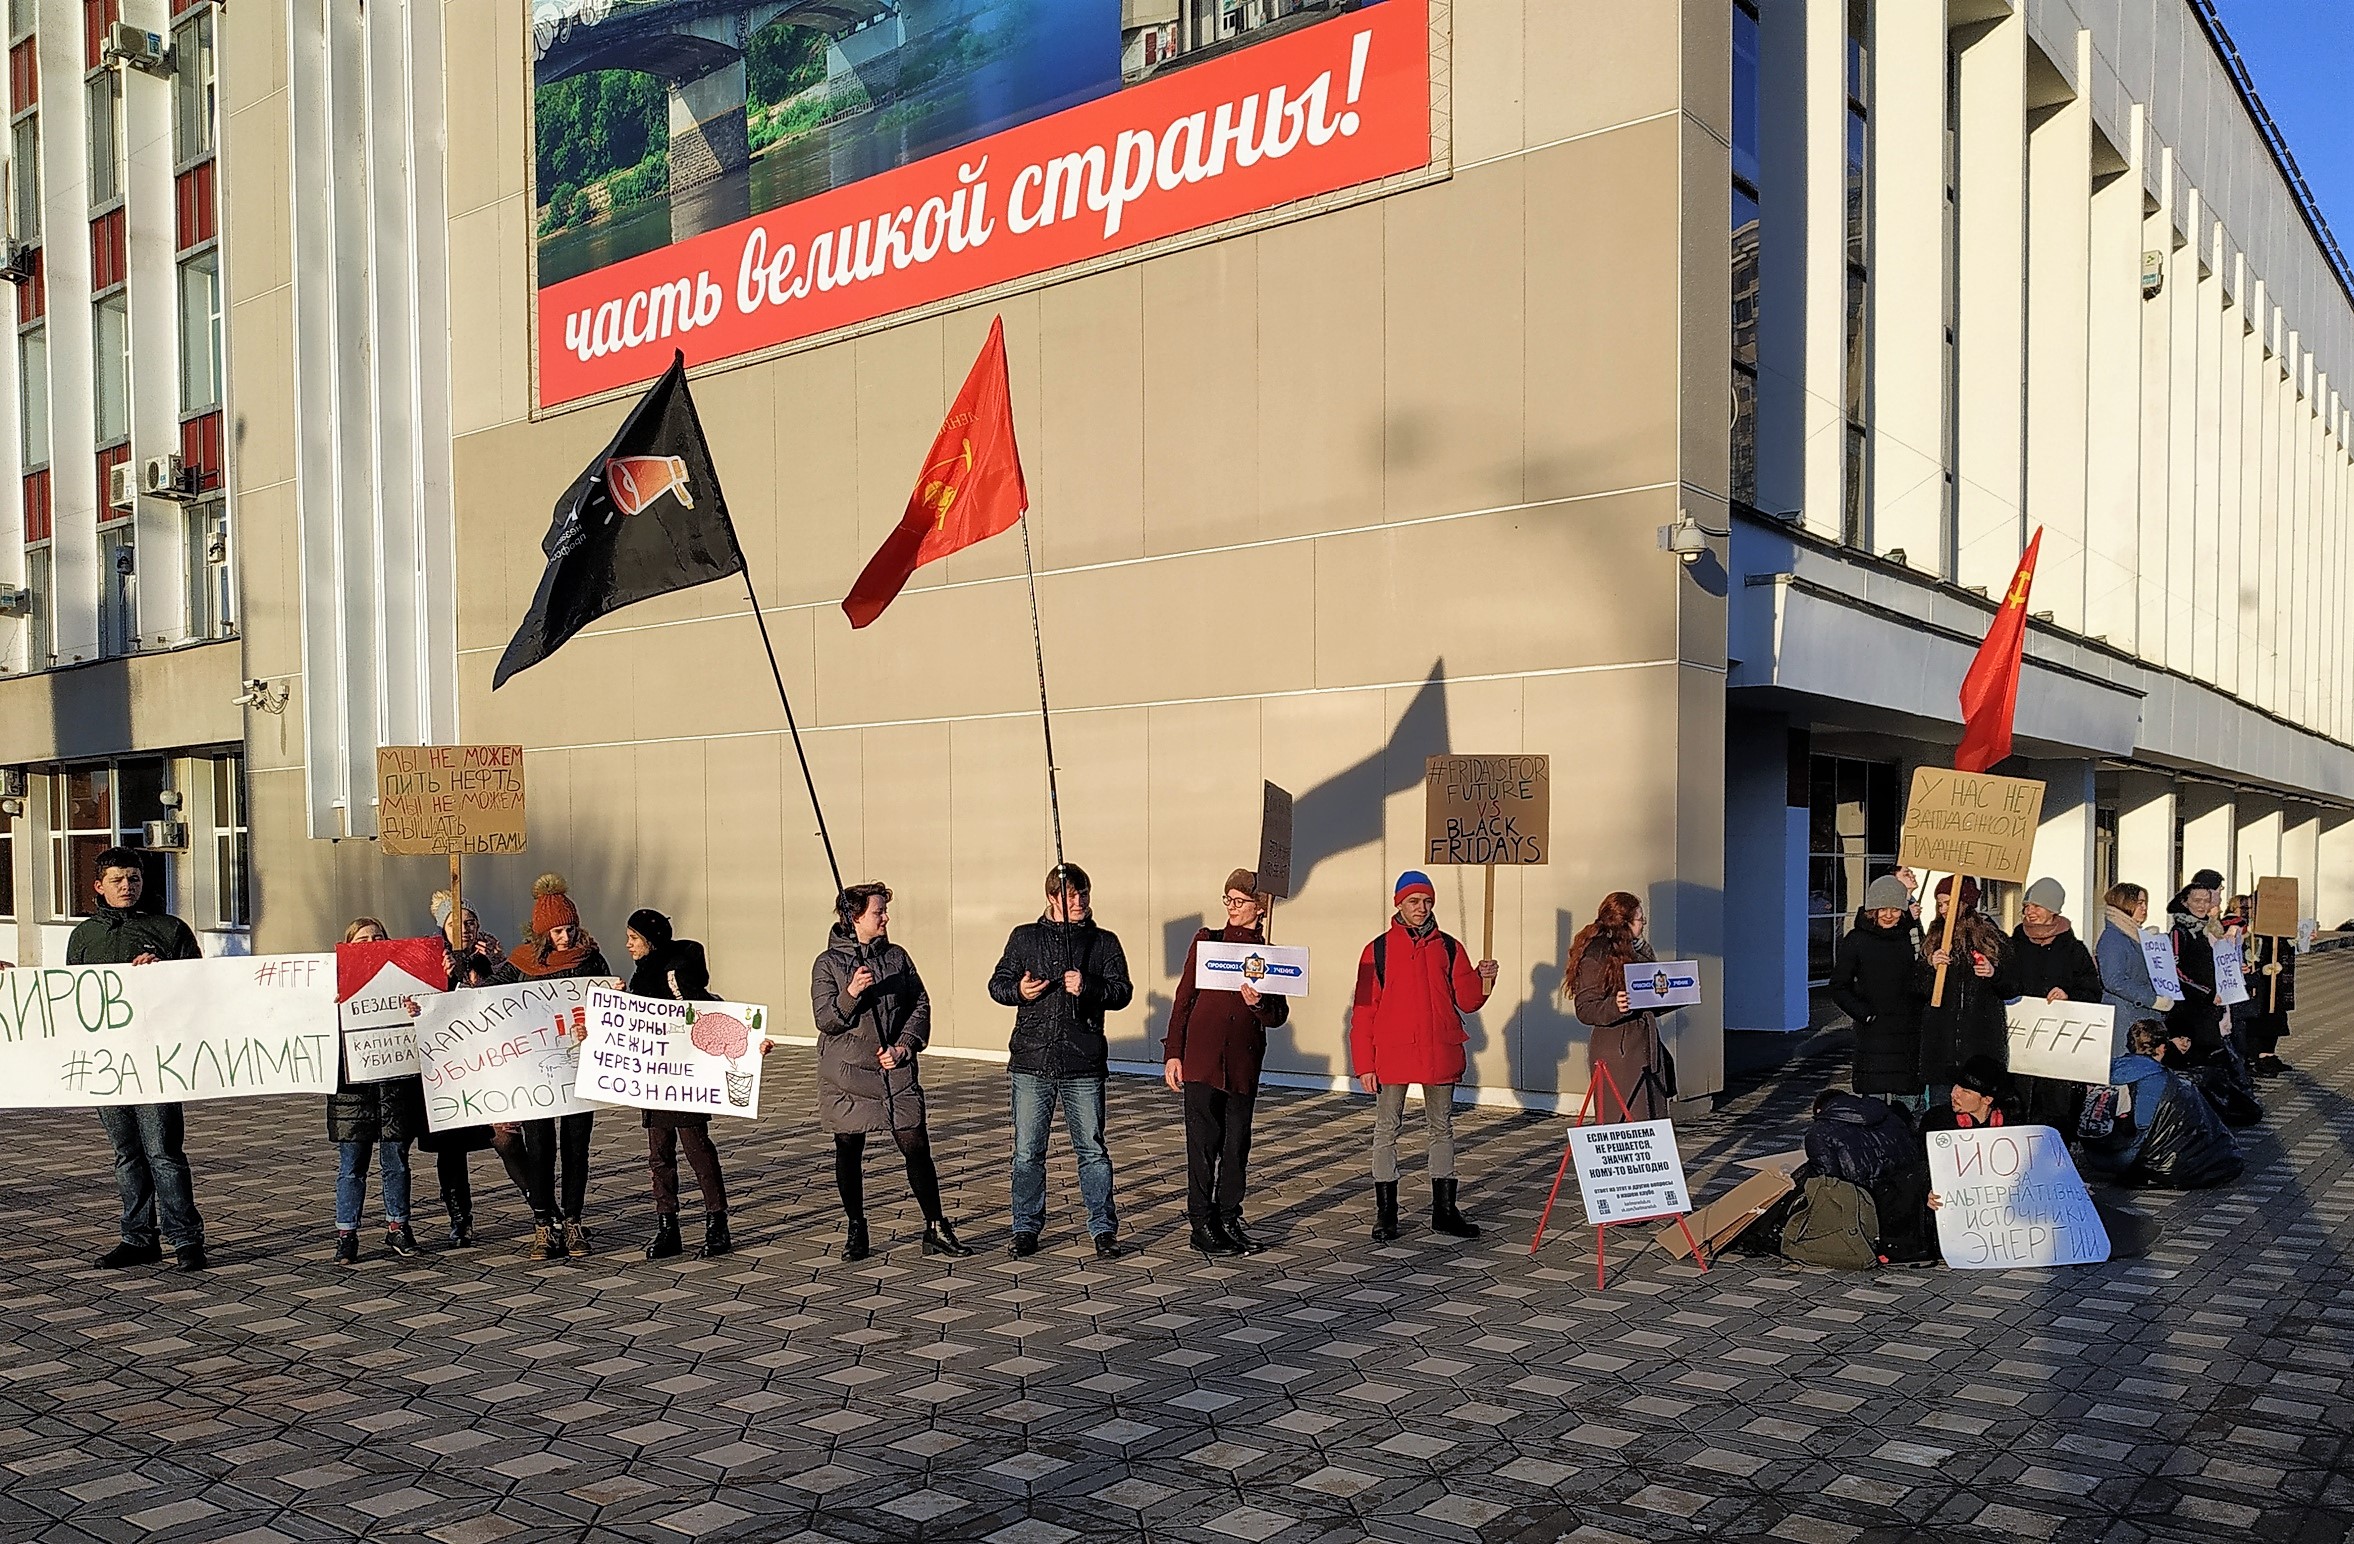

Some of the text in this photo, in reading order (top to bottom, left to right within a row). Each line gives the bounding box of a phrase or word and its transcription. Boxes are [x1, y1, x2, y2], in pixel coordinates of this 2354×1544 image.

[564, 29, 1374, 362] часть великой страны!
[379, 746, 523, 774] МЫ НЕ МОЖЕМ
[1428, 756, 1547, 785] #FRIDAYSFOR
[385, 769, 521, 796] ПИТЬ НЕФТЬ
[1447, 780, 1534, 804] FUTURE
[1917, 775, 2042, 815] У НАС НЕТ
[382, 791, 525, 817] МЫ НЕ МОЖЕМ
[1477, 800, 1501, 818] VS
[383, 815, 467, 840] ДЫШАТЬ
[1446, 816, 1520, 839] BLACK
[1907, 807, 2027, 841] ЗАПАСНОЙ
[431, 833, 528, 854] ДЕНЬГАМИ
[1430, 836, 1541, 863] FRIDAYS
[1902, 834, 2022, 873] ПЛАНЕТЫ
[254, 960, 320, 988] #FFF
[593, 992, 686, 1018] ПУТЬ МУСОРА
[419, 978, 613, 1062] КАПИТАЛИЗМ
[601, 1012, 667, 1036] ДО УРНЫ
[605, 1032, 670, 1057] ЛЕЖИТ
[2006, 1017, 2108, 1054] #FFF
[61, 1034, 330, 1095] #ЗА КЛИМАТ
[362, 1049, 420, 1068] УБИВА
[424, 1027, 548, 1090] УБИВАЕТ
[594, 1050, 695, 1077] ЧЕРЕЗ НАШЕ
[432, 1082, 575, 1123] ЭКОЛОГ
[597, 1075, 722, 1105] СОЗНАНИЕ
[1586, 1128, 1656, 1143] ЕСЛИ ПРОБЛЕМА
[1595, 1140, 1653, 1154] НЕ РЕШАЕТСЯ,
[1601, 1152, 1652, 1166] ЗНАЧИТ ЭТО
[1954, 1134, 2068, 1178] ЙОГИ
[1589, 1161, 1670, 1179] КОМУ-ТО ВЫГОДНО
[2011, 1171, 2033, 1188] ЗА
[1965, 1205, 2089, 1230] ИСТОЧНИКИ
[1962, 1225, 2100, 1265] ЭНЕРГИИ
